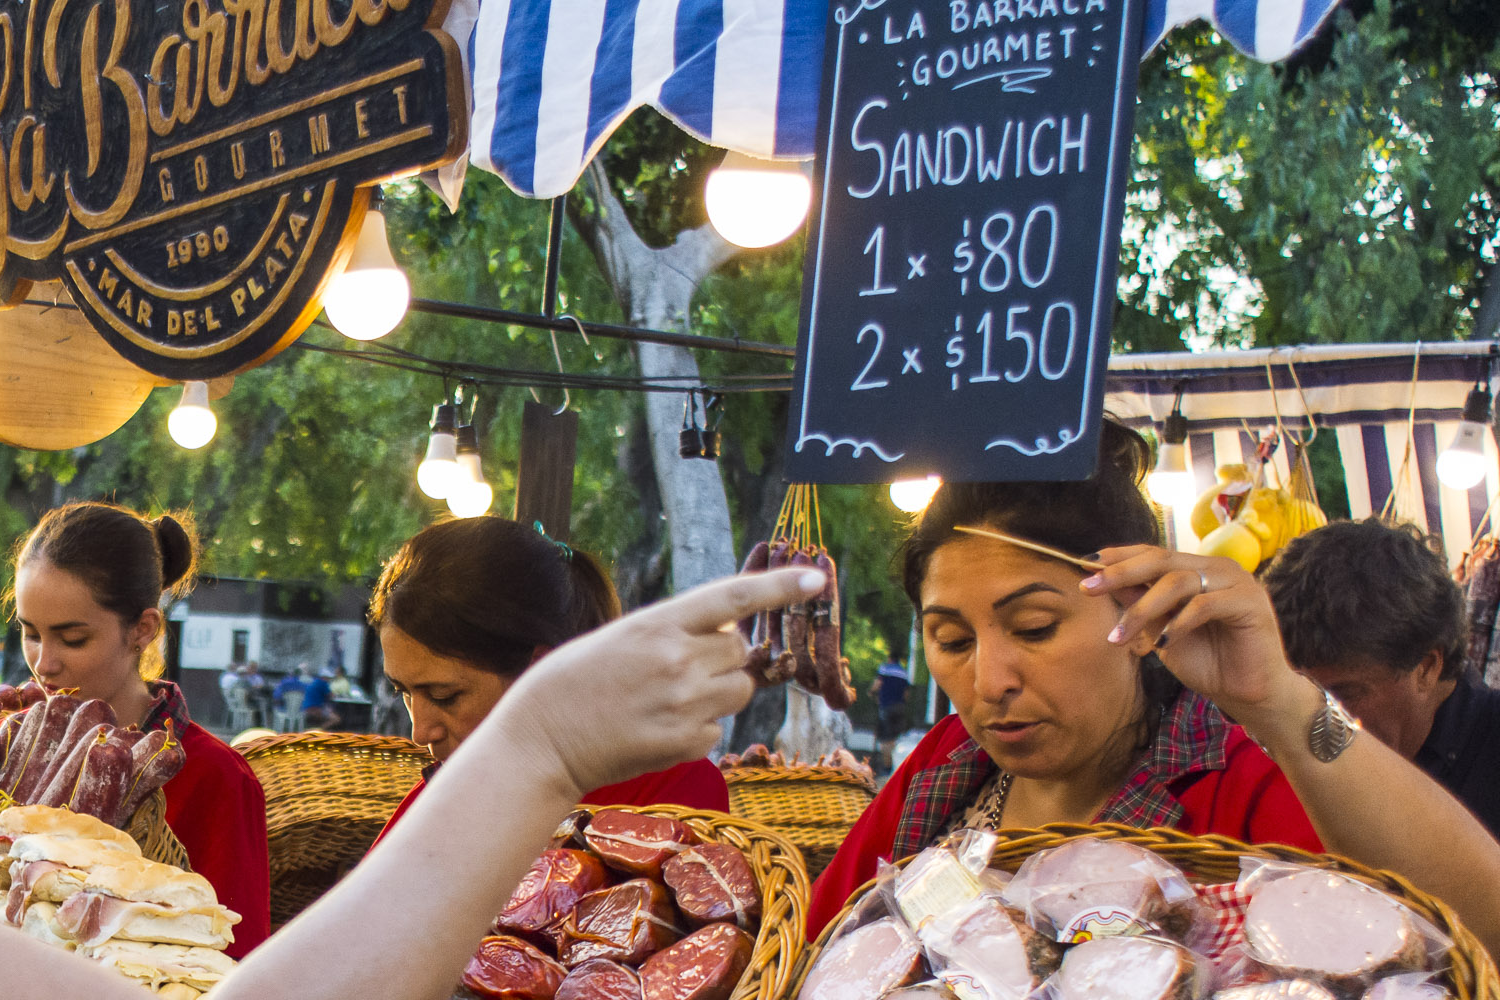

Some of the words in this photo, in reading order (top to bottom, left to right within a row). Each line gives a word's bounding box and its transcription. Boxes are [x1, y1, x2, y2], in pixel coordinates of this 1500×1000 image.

[883, 12, 926, 44] LA
[912, 27, 1077, 86] GOURMET
[158, 84, 410, 202] GOURMET
[847, 100, 1090, 199] SANDWICH
[97, 267, 154, 328] MAR
[166, 306, 222, 336] DEL
[230, 212, 309, 318] PLATA
[165, 225, 230, 269] 1990
[858, 226, 897, 296] 1
[953, 204, 1058, 295] $80
[850, 323, 890, 391] 2
[945, 301, 1077, 392] $150
